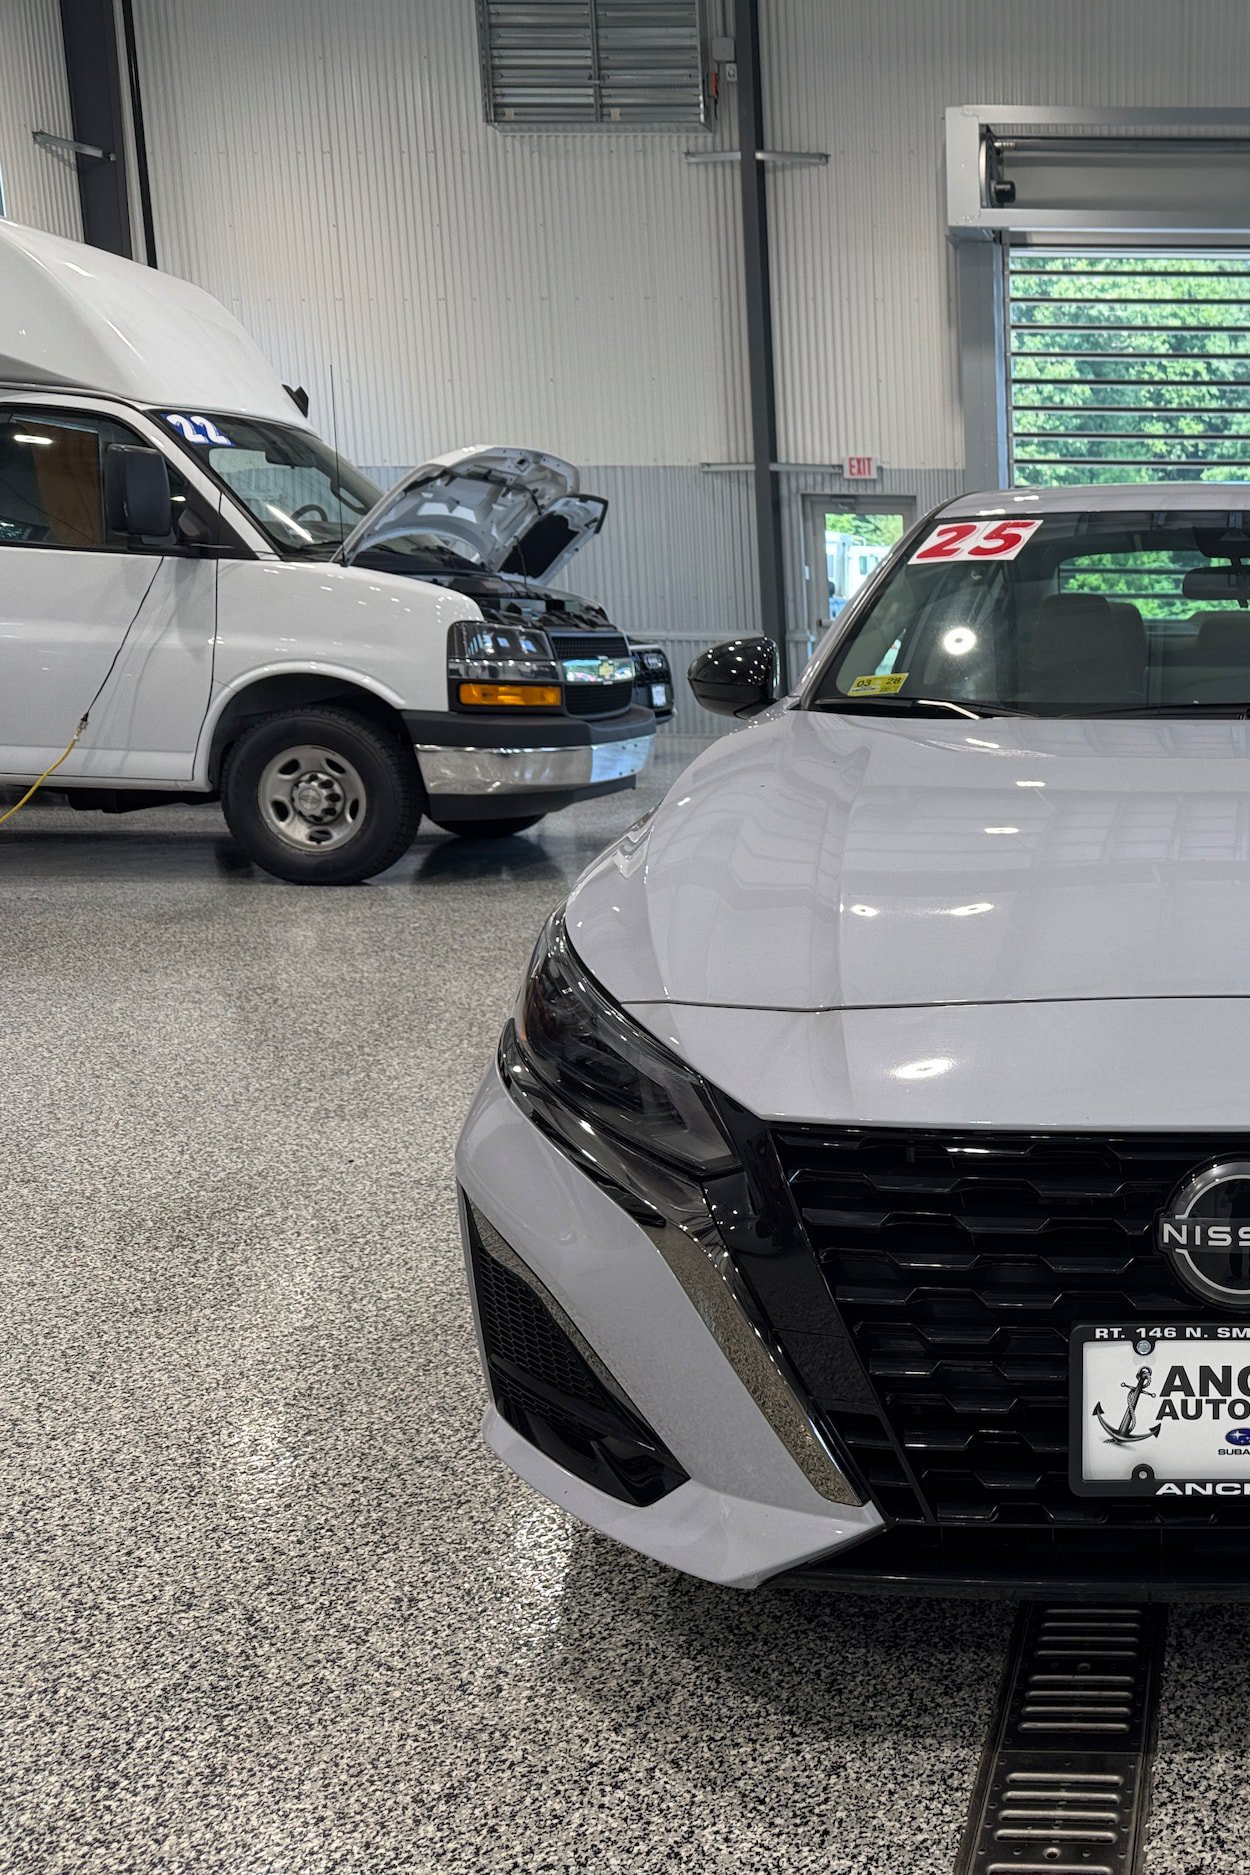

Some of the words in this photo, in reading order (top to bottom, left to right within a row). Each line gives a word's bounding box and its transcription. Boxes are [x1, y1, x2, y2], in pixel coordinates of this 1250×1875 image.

[166, 414, 232, 446] 22
[848, 456, 873, 477] EXIT
[915, 520, 1038, 560] 25
[856, 679, 872, 688] 03
[1094, 1327, 1126, 1339] RT.
[1135, 1326, 1177, 1338] 146
[1185, 1327, 1209, 1338] N.
